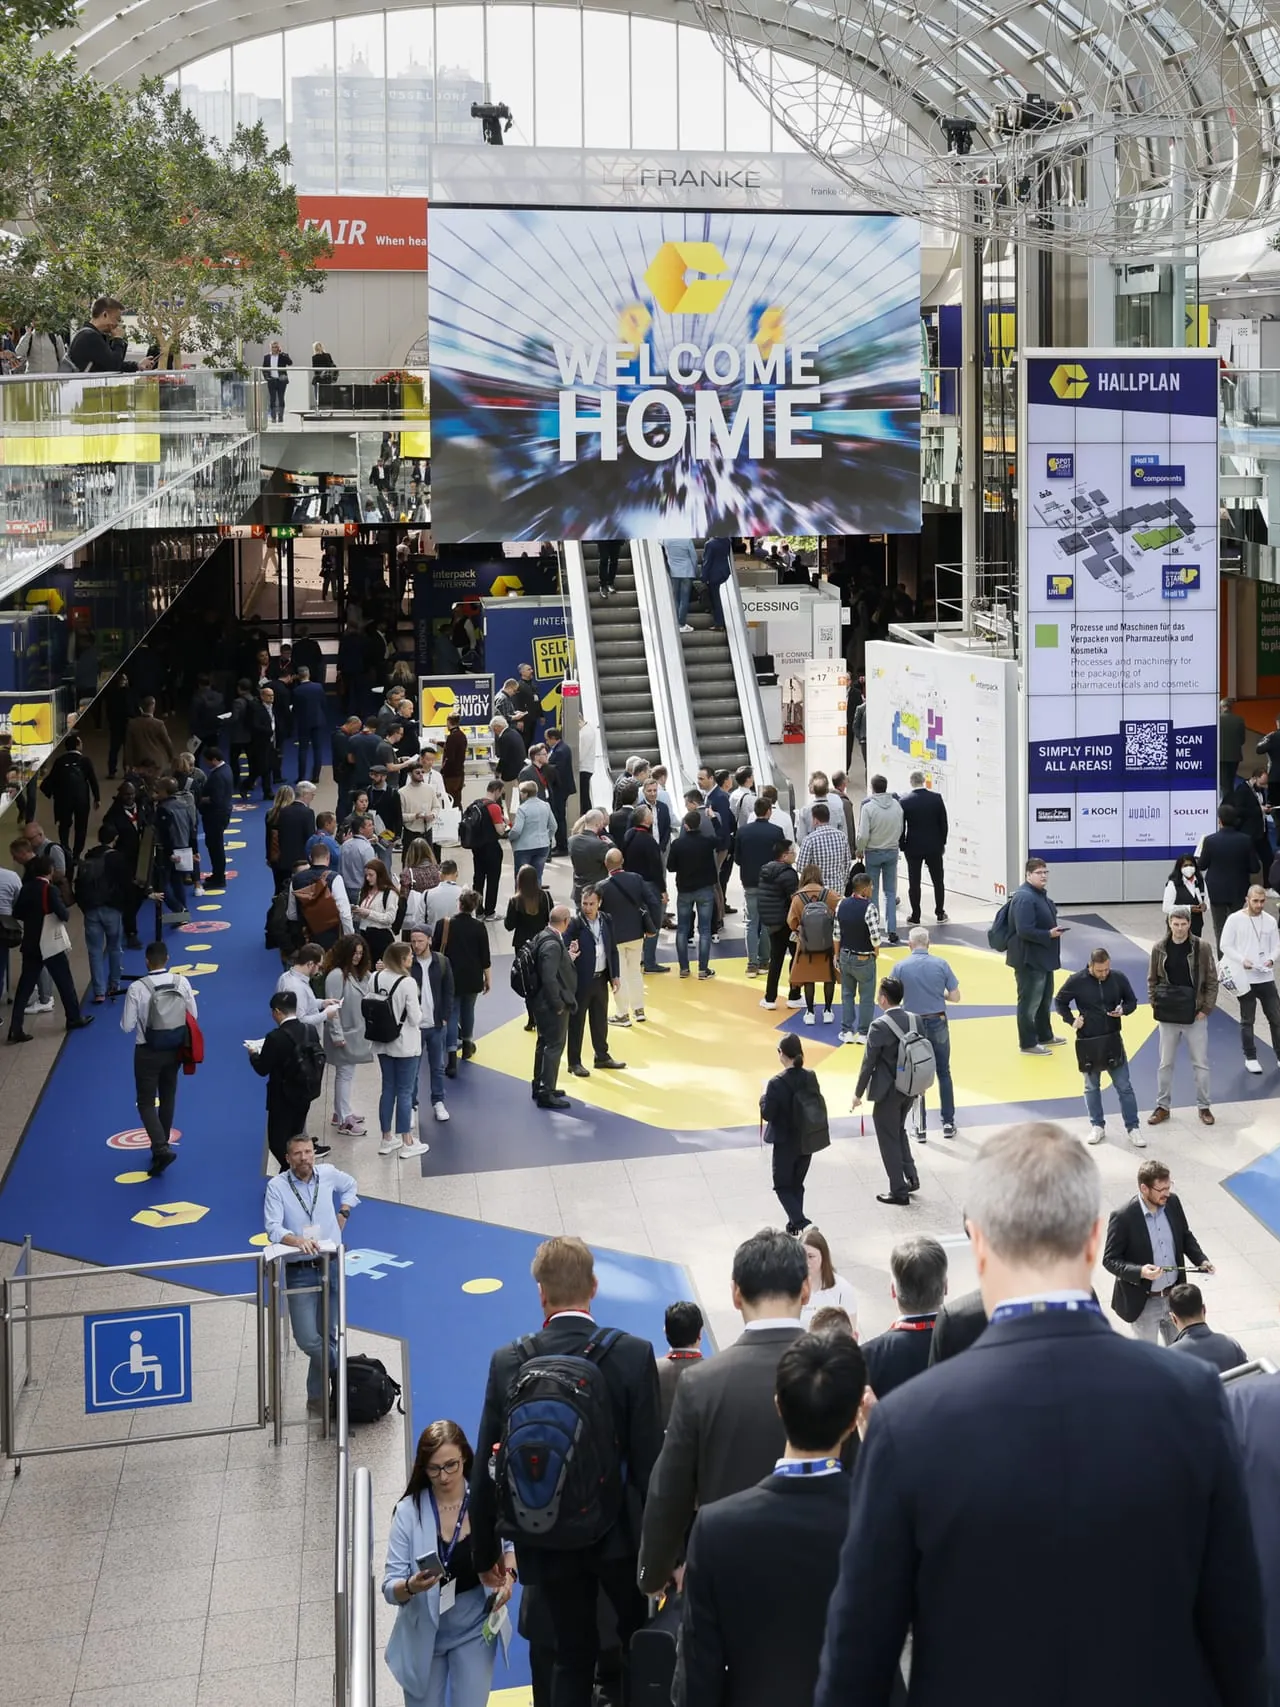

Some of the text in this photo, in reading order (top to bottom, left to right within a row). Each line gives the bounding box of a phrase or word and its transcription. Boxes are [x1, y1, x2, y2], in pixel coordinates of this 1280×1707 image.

[640, 169, 761, 188] FRANKE
[376, 236, 405, 246] When
[552, 343, 820, 386] WELCOME
[1098, 373, 1180, 391] HALLPLAN
[558, 388, 823, 462] HOME
[1143, 475, 1182, 483] components
[433, 569, 476, 580] interpack
[1261, 598, 1270, 607] of
[1070, 623, 1185, 632] Prozesse und Maschinen für das
[1070, 635, 1109, 644] Verpacken
[1126, 634, 1179, 643] Pharmazeutika
[1180, 634, 1194, 642] und
[1070, 646, 1108, 655] Kosmetika
[1261, 641, 1269, 650] to
[1070, 658, 1113, 666] Processes
[1134, 657, 1178, 667] machinery
[1180, 657, 1192, 665] for
[1070, 669, 1141, 679] the packaging of
[1070, 680, 1199, 690] pharmaceuticals and cosmetic
[454, 694, 490, 704] SIMPLY
[453, 703, 490, 717] ENJOY
[1175, 735, 1203, 745] SCAN
[1038, 746, 1113, 757] SIMPLY FIND
[1175, 749, 1191, 757] ME
[1045, 760, 1112, 771] ALL AREAS!
[1175, 761, 1203, 770] NOW!
